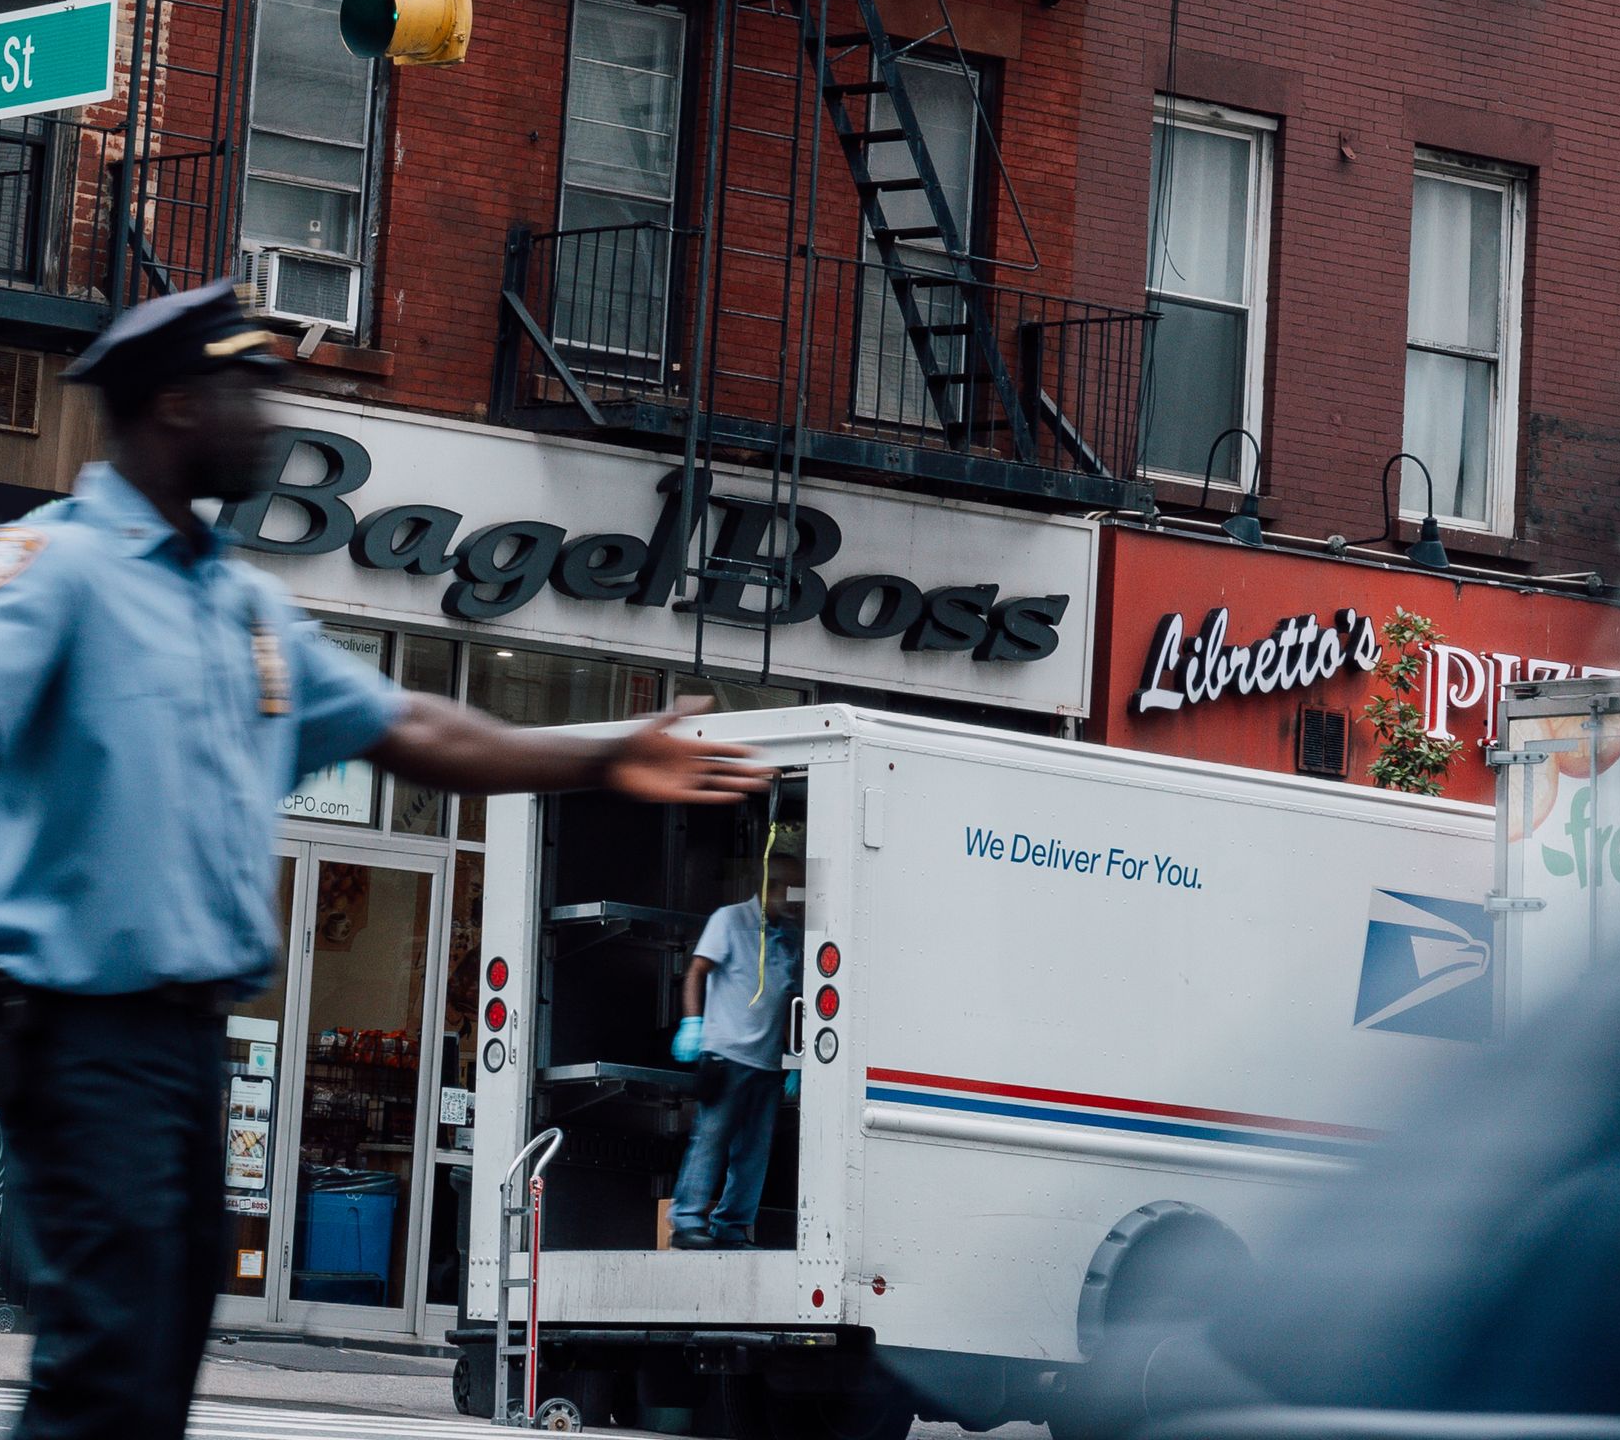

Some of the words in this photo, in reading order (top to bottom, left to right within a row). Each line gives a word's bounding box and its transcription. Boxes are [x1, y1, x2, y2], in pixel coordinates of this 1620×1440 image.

[1, 34, 35, 94] St
[216, 425, 714, 620] Bagel
[673, 496, 1069, 663] Boss
[1130, 607, 1383, 714] Libretto's
[965, 826, 1005, 861] We
[1010, 833, 1102, 875] Deliver
[1105, 847, 1150, 881] For
[1154, 854, 1203, 890] You.
